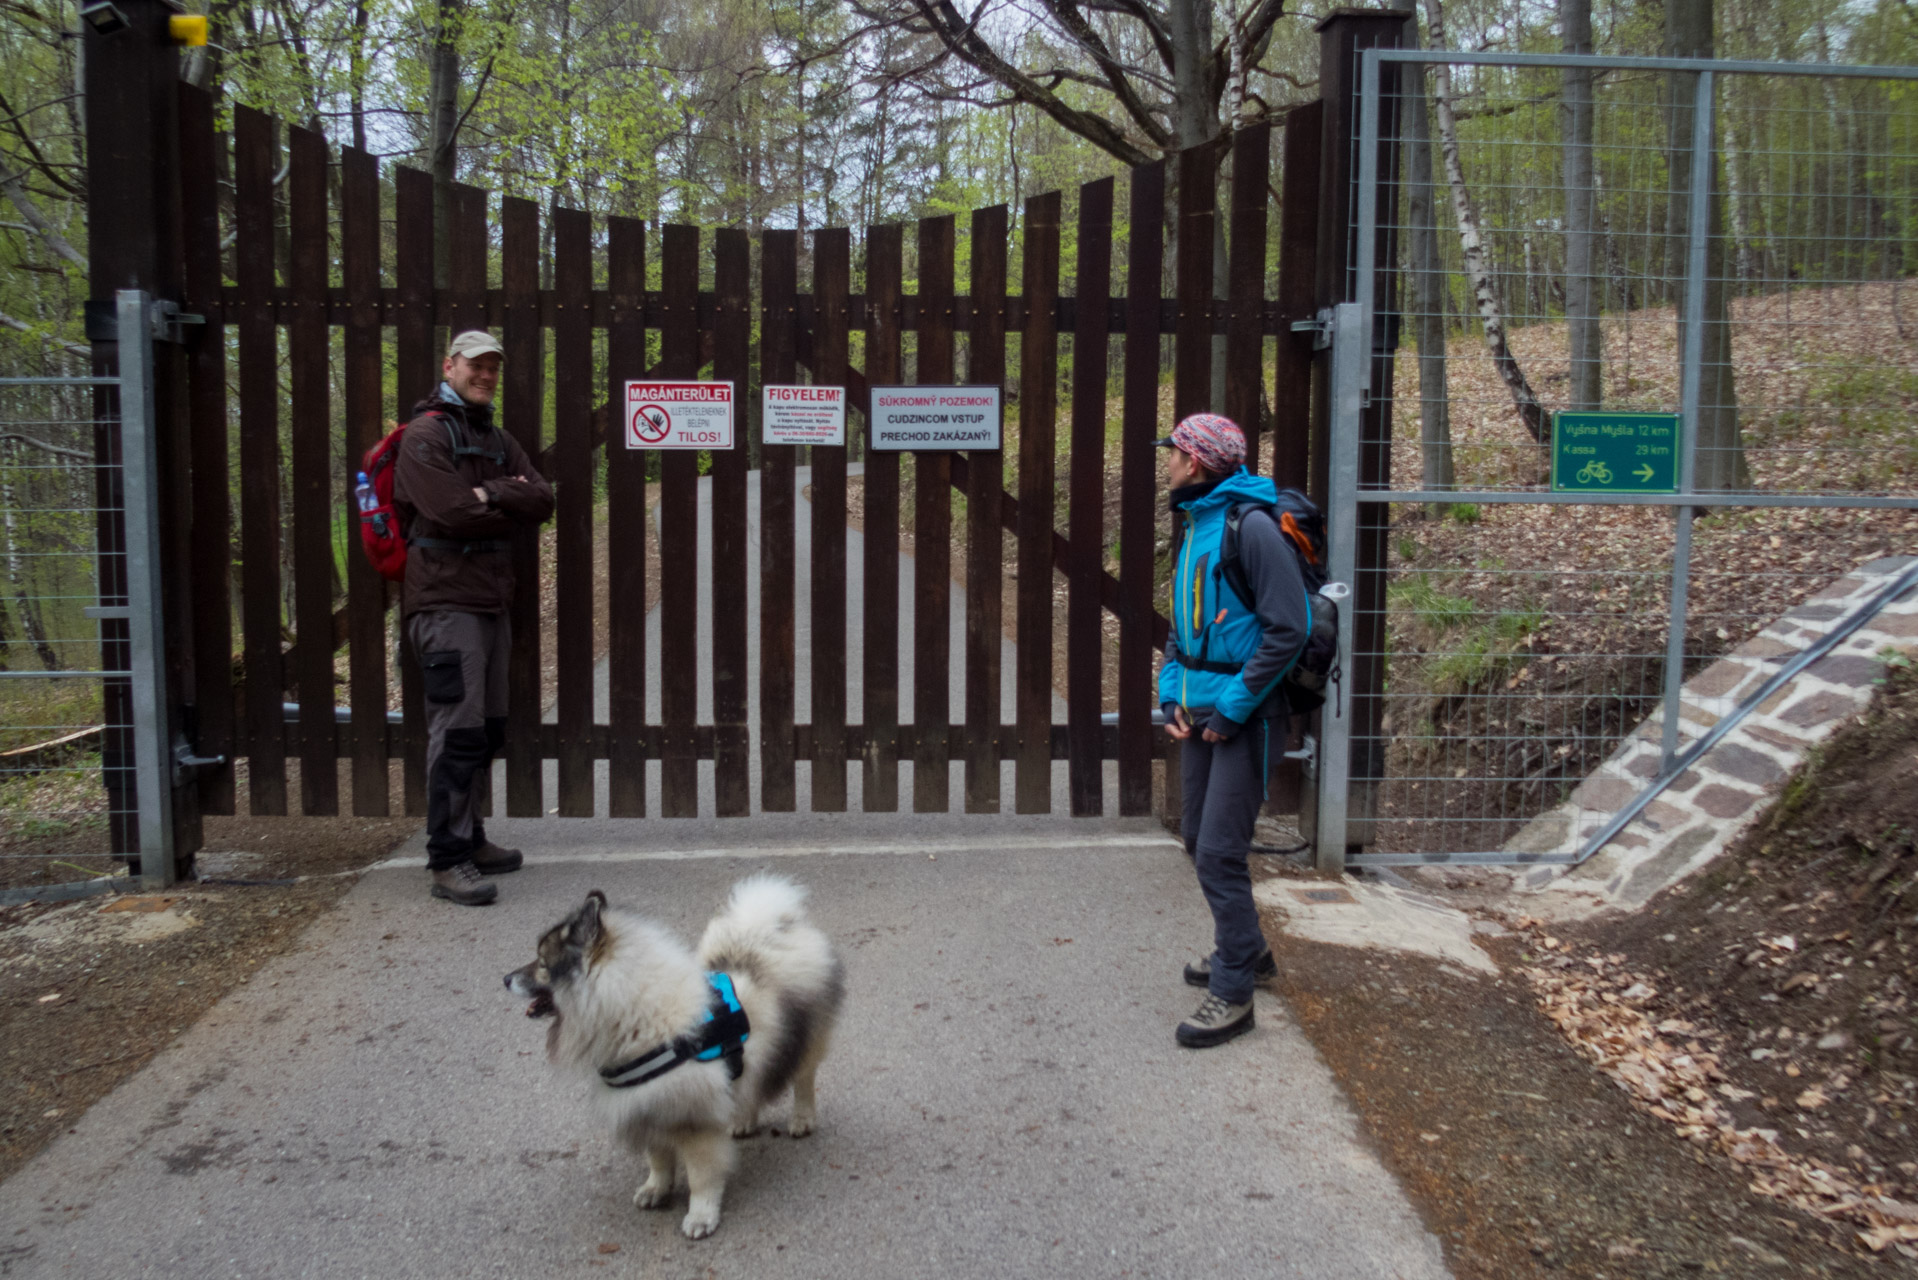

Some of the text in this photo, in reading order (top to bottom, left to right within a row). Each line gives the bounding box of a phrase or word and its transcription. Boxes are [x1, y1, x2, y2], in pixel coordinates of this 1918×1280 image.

[630, 386, 730, 400] MAGÁNTERÜLET
[769, 388, 840, 401] FIGYELEM!
[879, 395, 992, 406] SÚKROMNÝ POZEMOK!
[888, 414, 984, 423] CUDZINCOM VSTUP
[881, 430, 991, 441] PRECHOD ZAKÁZANÝ!
[1638, 425, 1648, 436] 12
[1651, 426, 1669, 436] km
[678, 432, 721, 442] TILOS!
[1563, 444, 1669, 455] Kassa 29 km
